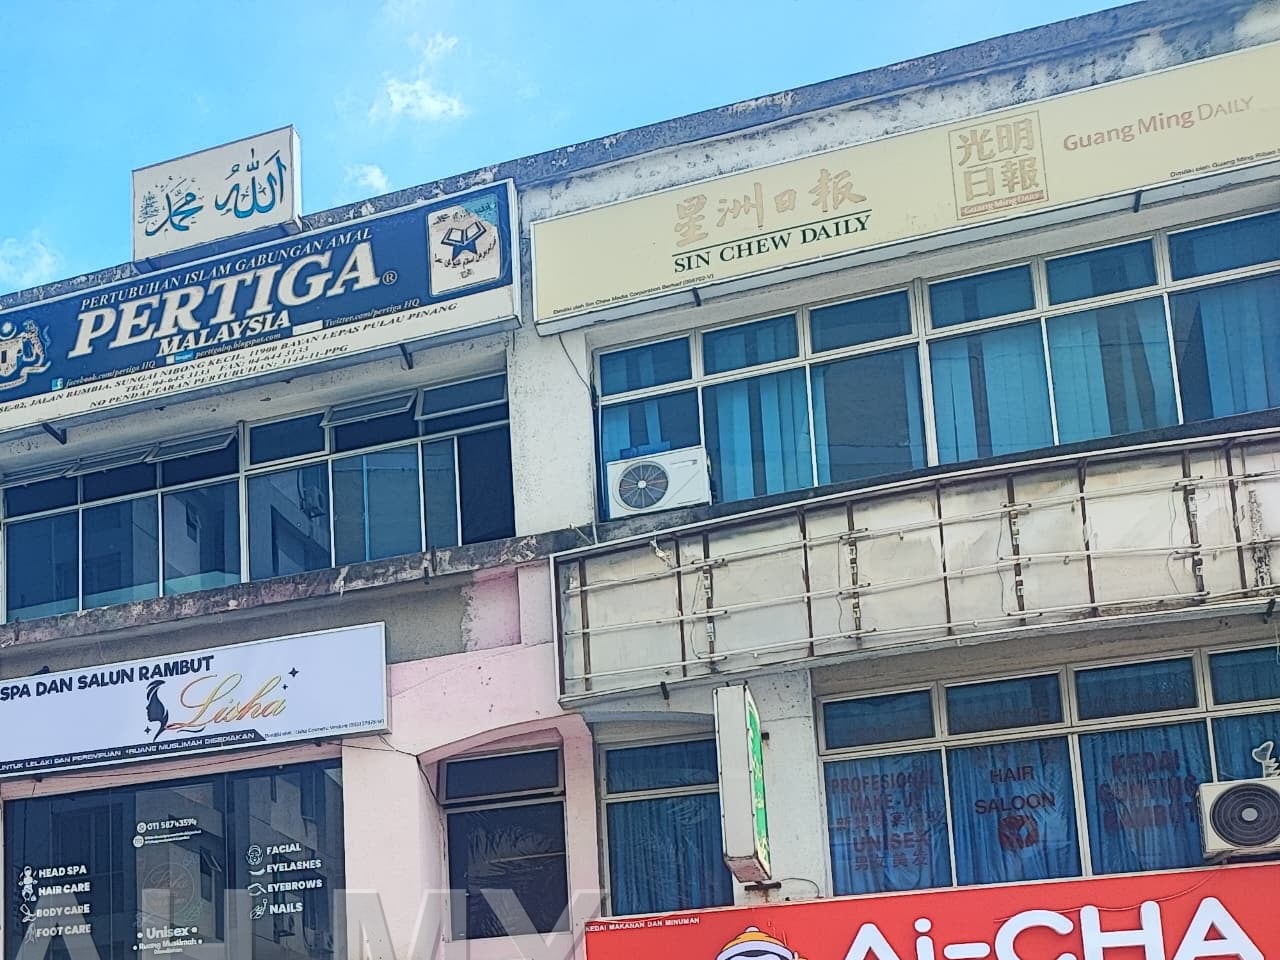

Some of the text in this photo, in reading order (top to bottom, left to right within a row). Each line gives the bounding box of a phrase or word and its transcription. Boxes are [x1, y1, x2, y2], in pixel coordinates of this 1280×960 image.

[1063, 95, 1255, 151] Guang Ming DAILY
[956, 118, 1034, 167] 光明
[963, 157, 1040, 202] 日報
[674, 214, 872, 273] SIN CHEW DAILY
[81, 227, 373, 311] PERTUBUHAN ISLAM GABUNGAN AMAL
[67, 242, 381, 359] PERTIGA
[155, 310, 292, 358] MALAYSIA
[29, 392, 64, 406] JALAN
[114, 373, 160, 388] SUNGAI
[161, 362, 206, 377] NIBONG
[280, 335, 320, 350] BAYAN
[321, 326, 360, 341] LEPAS
[363, 316, 404, 331] PULAU
[407, 303, 458, 322] PINANG
[89, 398, 107, 408] NO
[109, 381, 191, 403] PENDAFTARAN
[0, 655, 215, 702] SPA DAN SALUN RAMBUT
[25, 758, 53, 768] LELAKI
[54, 756, 71, 764] DAN
[158, 739, 203, 752] MUSLIMAH
[204, 732, 256, 747] DISEDIAKAN
[990, 765, 1034, 784] HAIR
[975, 792, 1055, 815] SALOON
[266, 843, 301, 855] FACIAL
[38, 865, 87, 878] HEAD SPA
[266, 860, 322, 873] EYELASHES
[38, 882, 91, 896] HAIR CARE
[267, 879, 323, 893] EYEBROWS
[36, 904, 90, 918] BODY CARE
[269, 902, 303, 915] NAILS
[36, 924, 91, 938] FOOT CARE
[146, 926, 189, 939] Unisex
[609, 922, 644, 930] MAKANAN
[665, 917, 699, 926] MINUMAN
